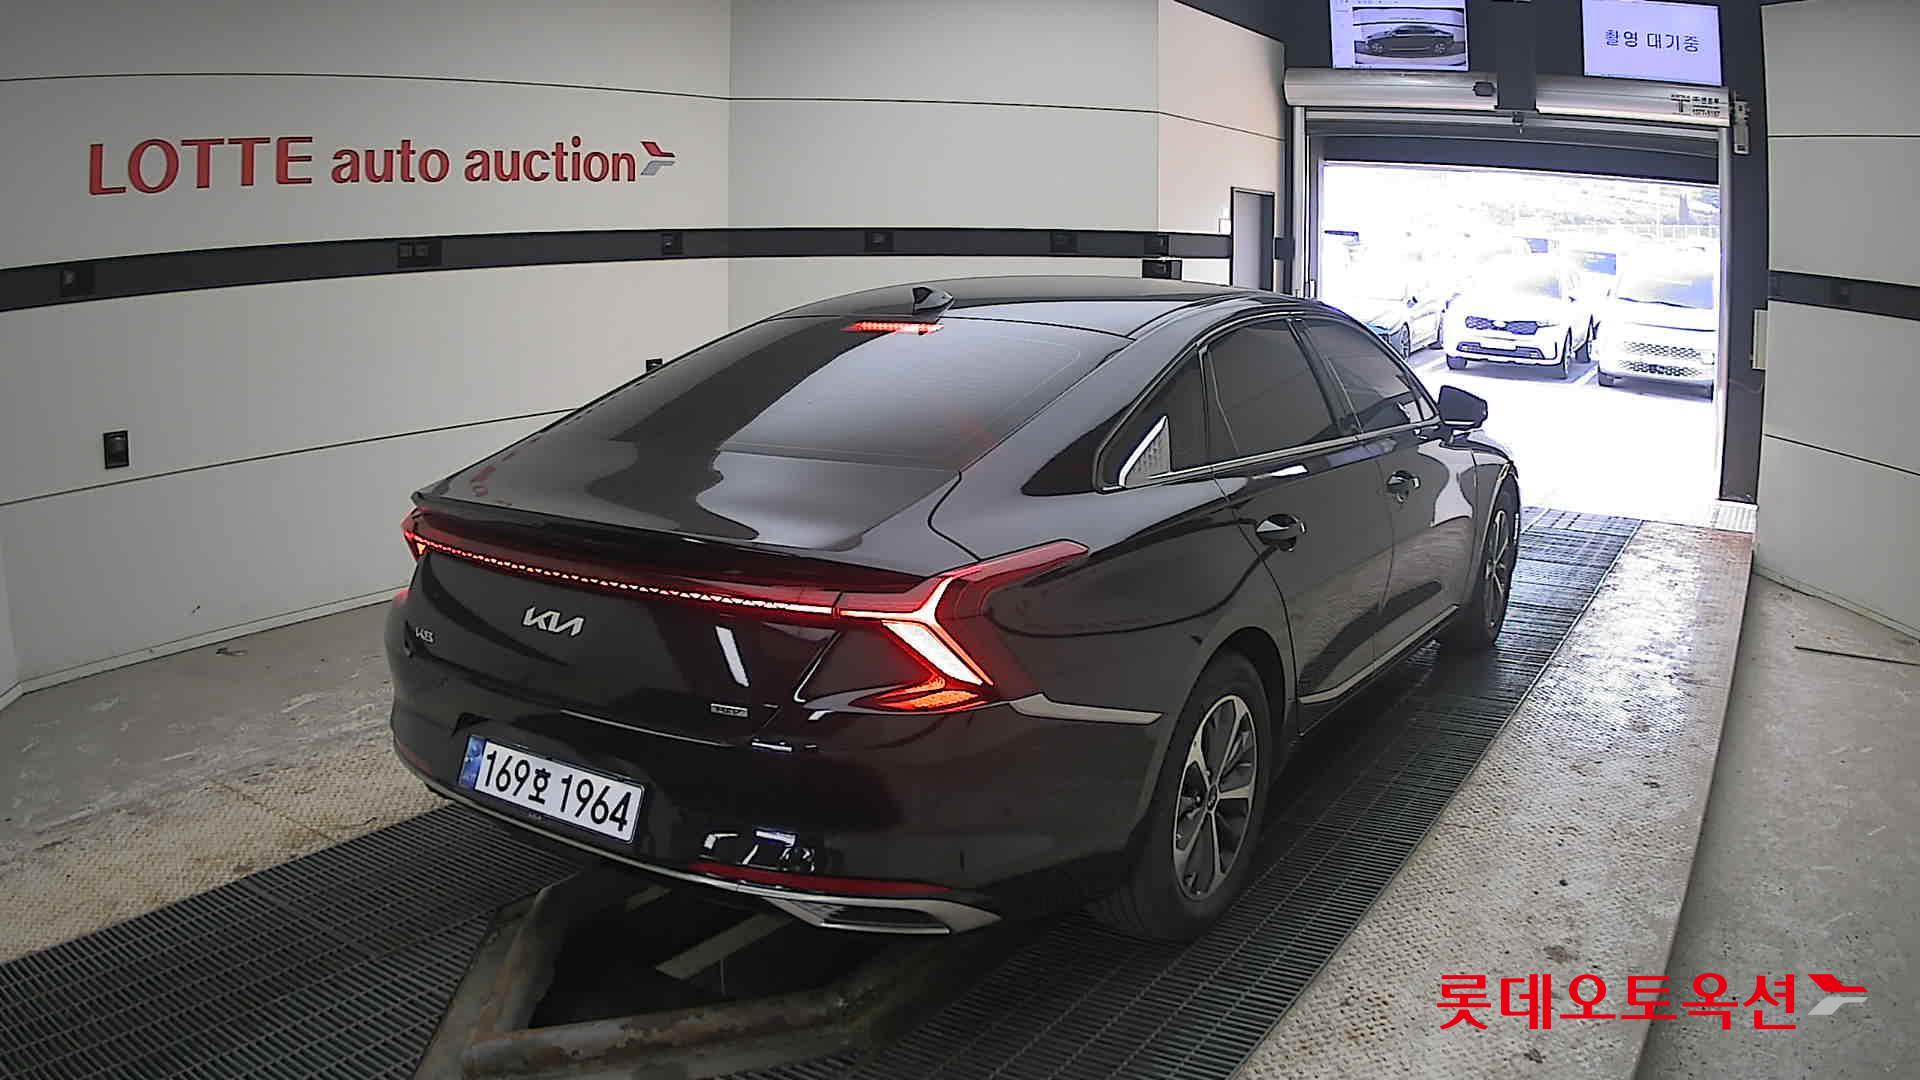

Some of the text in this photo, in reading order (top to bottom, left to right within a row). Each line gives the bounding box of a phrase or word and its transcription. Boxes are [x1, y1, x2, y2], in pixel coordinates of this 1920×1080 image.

[1647, 33, 1699, 53] 대기중
[89, 135, 636, 195] LOTTE auto auction
